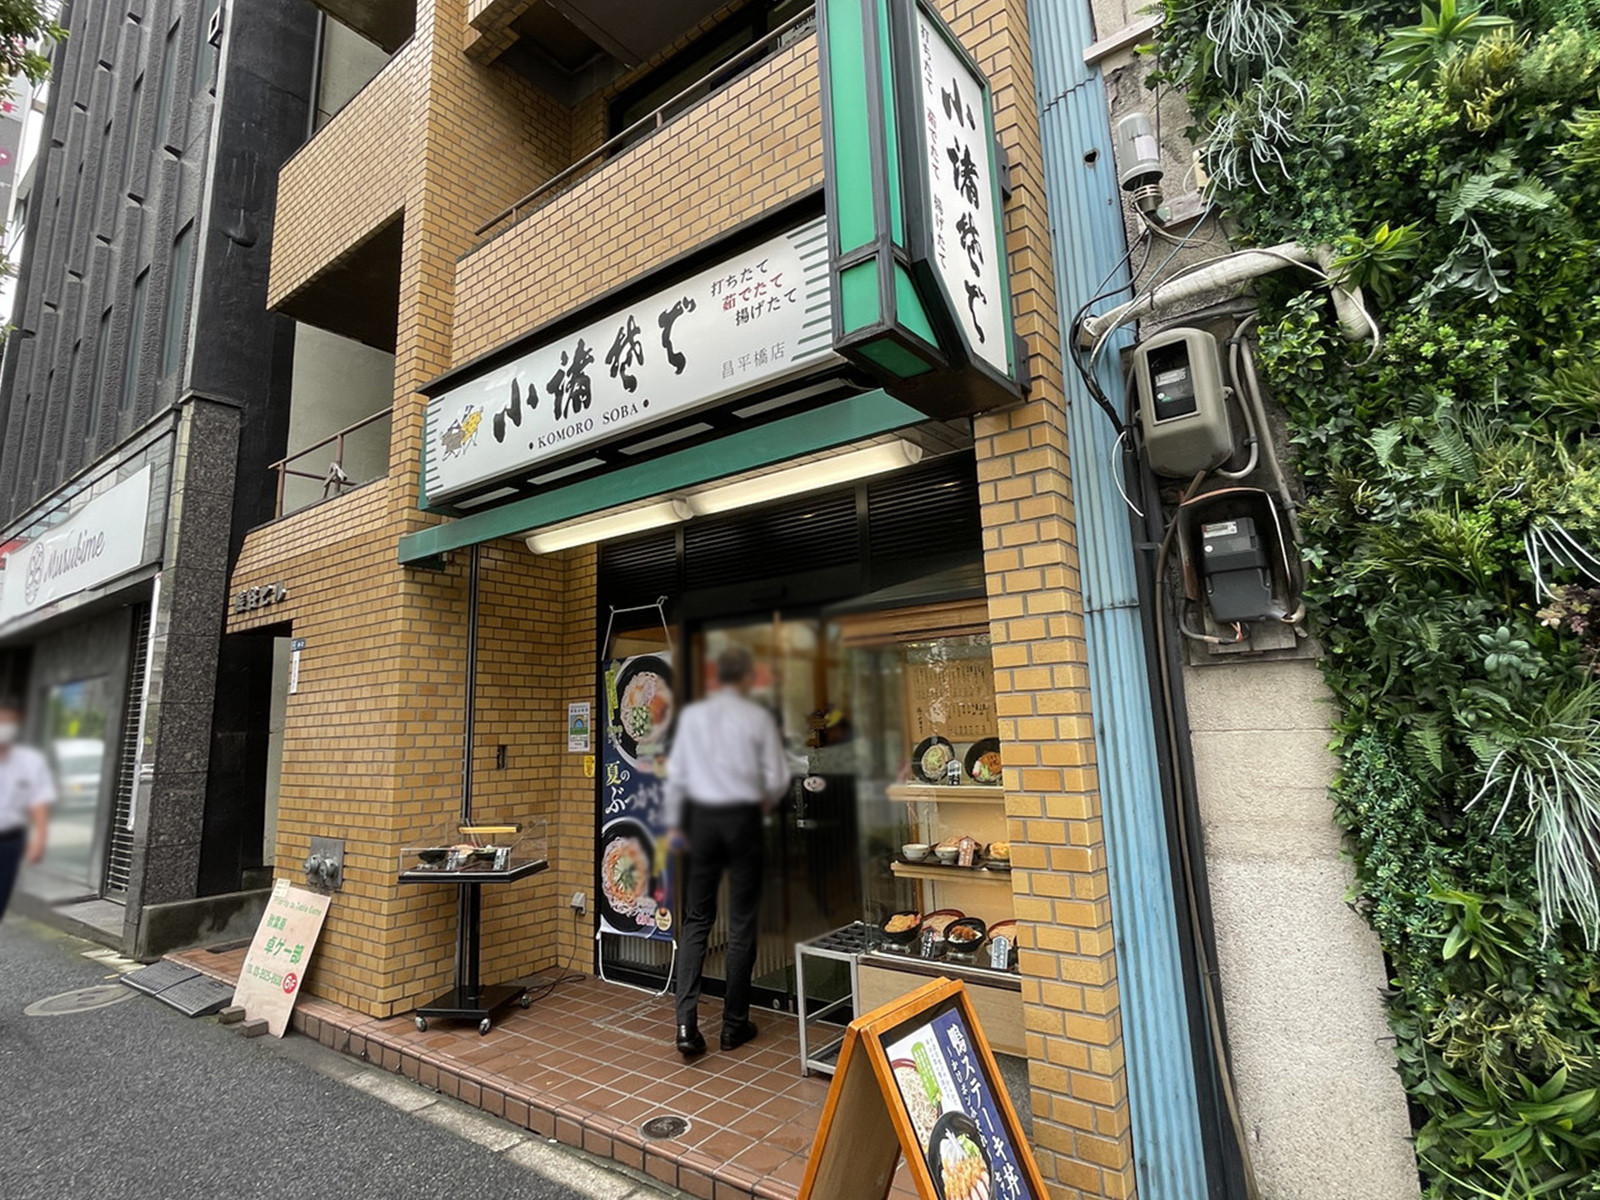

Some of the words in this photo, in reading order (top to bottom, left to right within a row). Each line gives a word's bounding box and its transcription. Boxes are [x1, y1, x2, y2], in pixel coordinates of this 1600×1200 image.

[710, 258, 769, 297] 打ちたて
[722, 272, 783, 311] 茹でたて
[735, 287, 797, 326] 揚げたて
[722, 342, 785, 379] 昌平橋店
[537, 418, 594, 449] KOMORO
[602, 403, 639, 425] SOBA
[605, 760, 631, 787] 夏の
[284, 975, 297, 991] 6F
